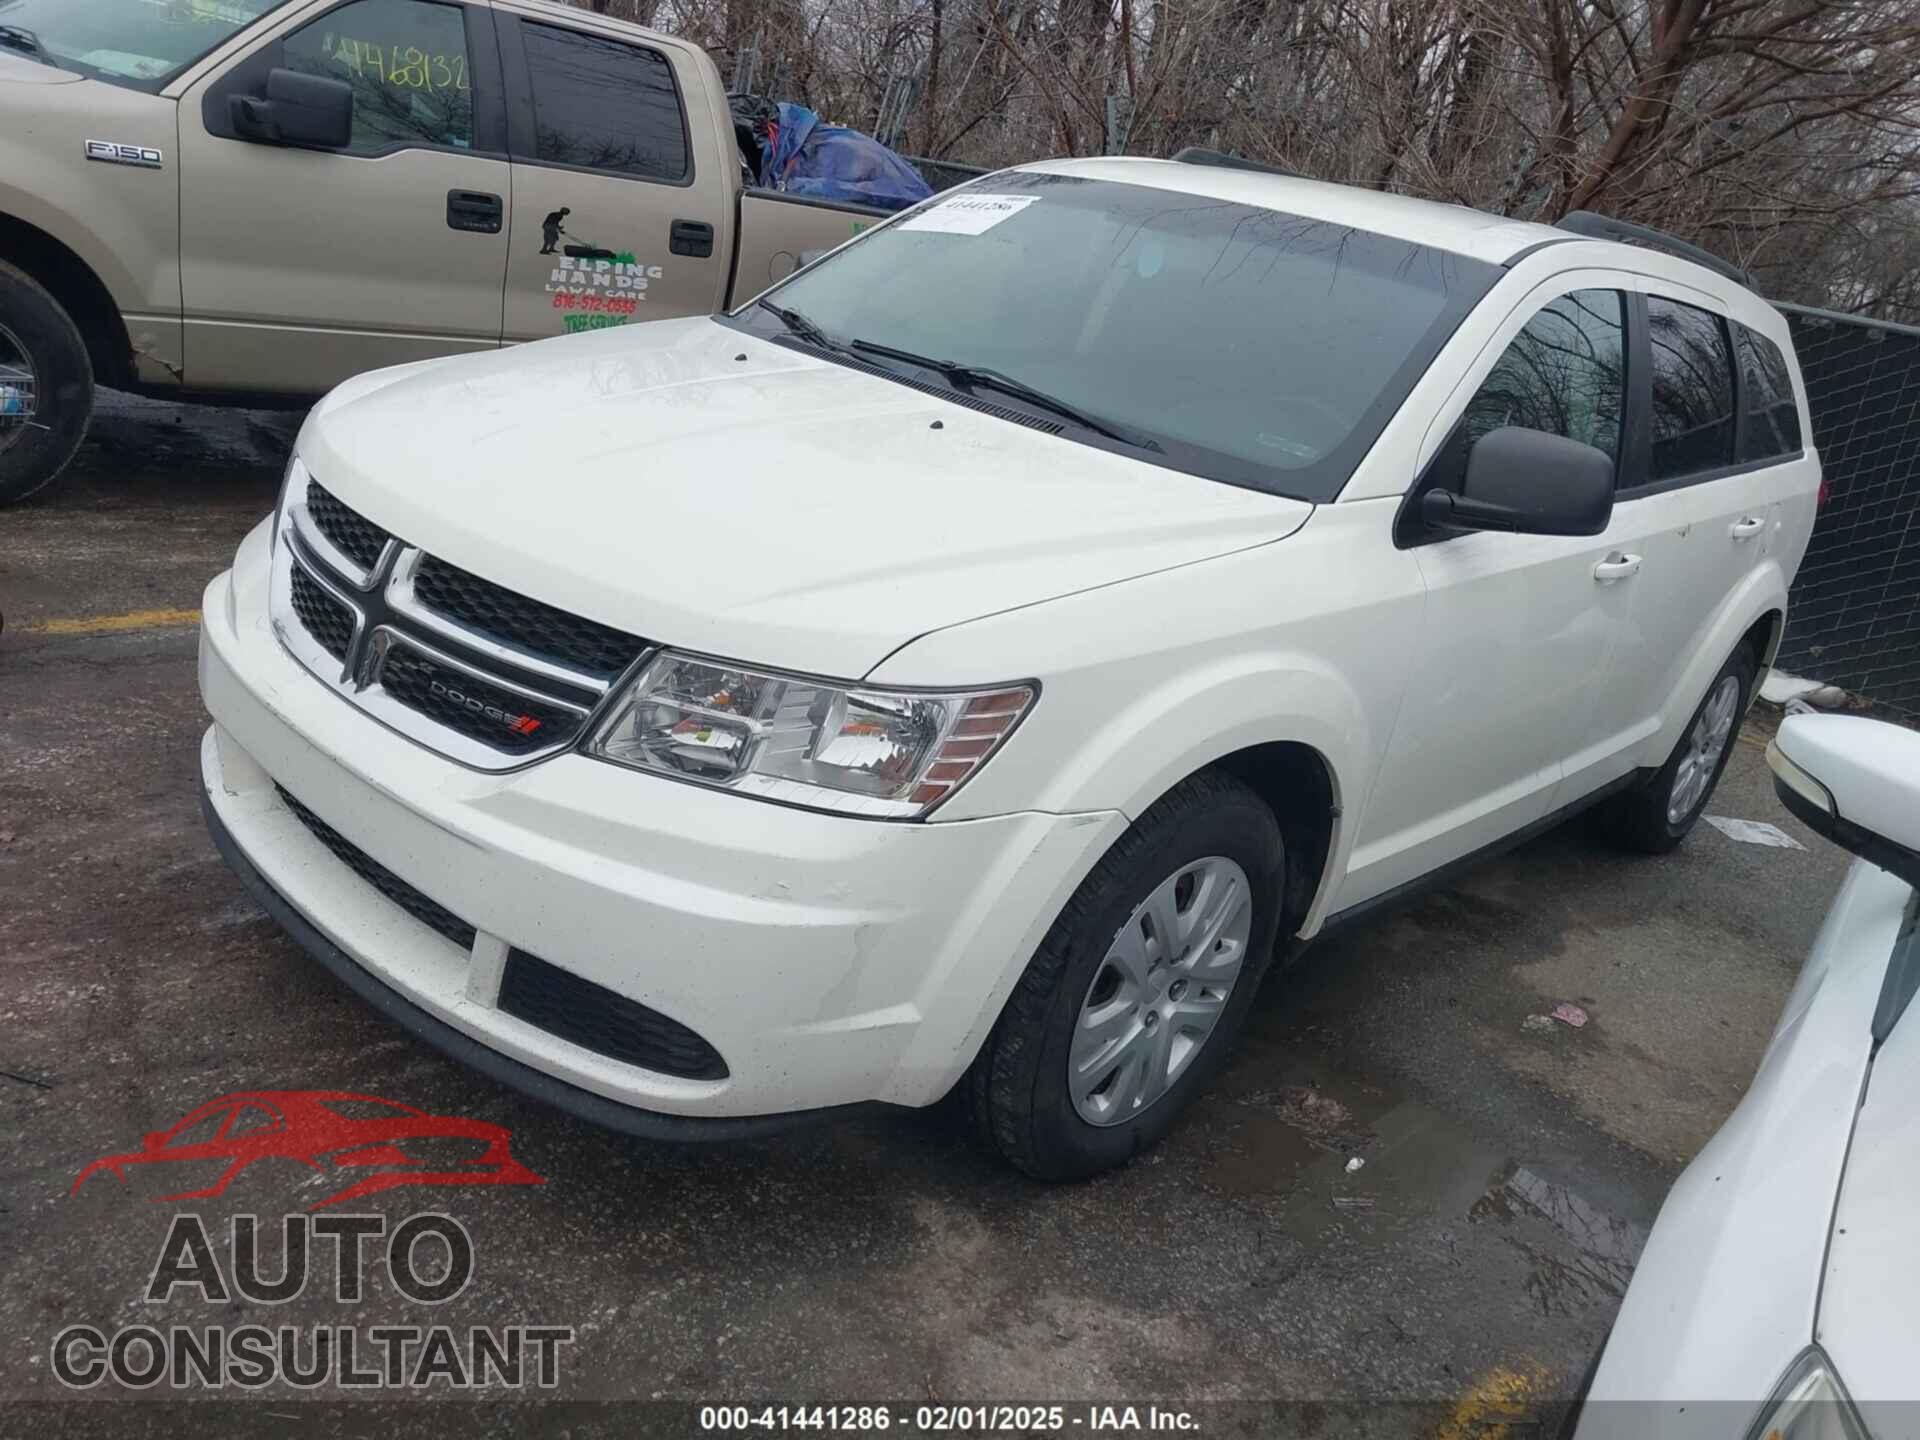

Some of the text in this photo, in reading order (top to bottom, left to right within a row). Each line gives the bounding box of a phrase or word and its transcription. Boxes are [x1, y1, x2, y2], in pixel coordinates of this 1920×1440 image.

[559, 256, 663, 279] ELPING
[551, 269, 648, 290] HANDS
[545, 283, 648, 300] LAWN CARE
[430, 681, 523, 728] DODGE
